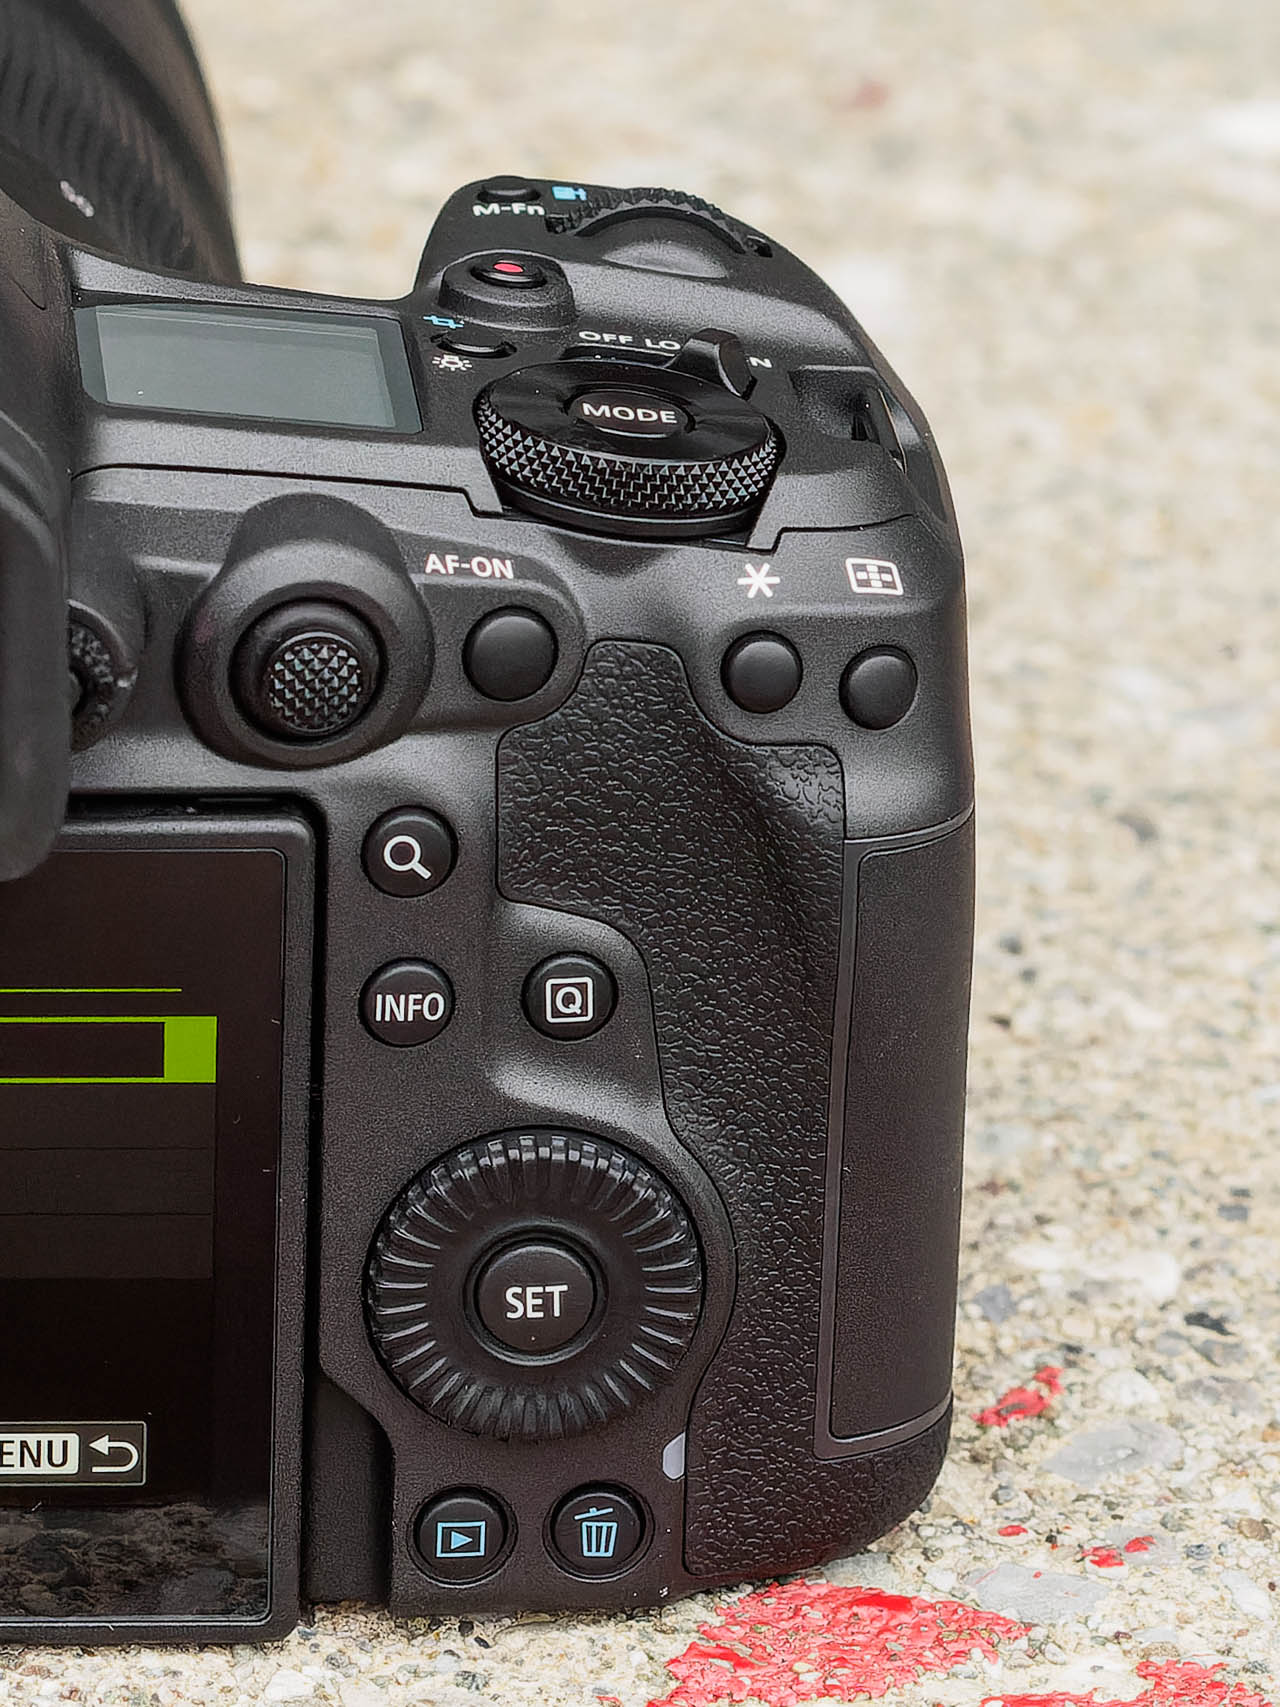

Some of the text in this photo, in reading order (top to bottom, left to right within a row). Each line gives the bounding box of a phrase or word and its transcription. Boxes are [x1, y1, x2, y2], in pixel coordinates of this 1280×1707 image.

[472, 202, 545, 217] M-Fn
[577, 330, 773, 369] OFF LO N
[582, 402, 678, 424] MODE
[424, 552, 515, 580] AF-ON
[375, 992, 445, 1022] INFO
[555, 985, 583, 1016] Q
[505, 1284, 569, 1319] SET
